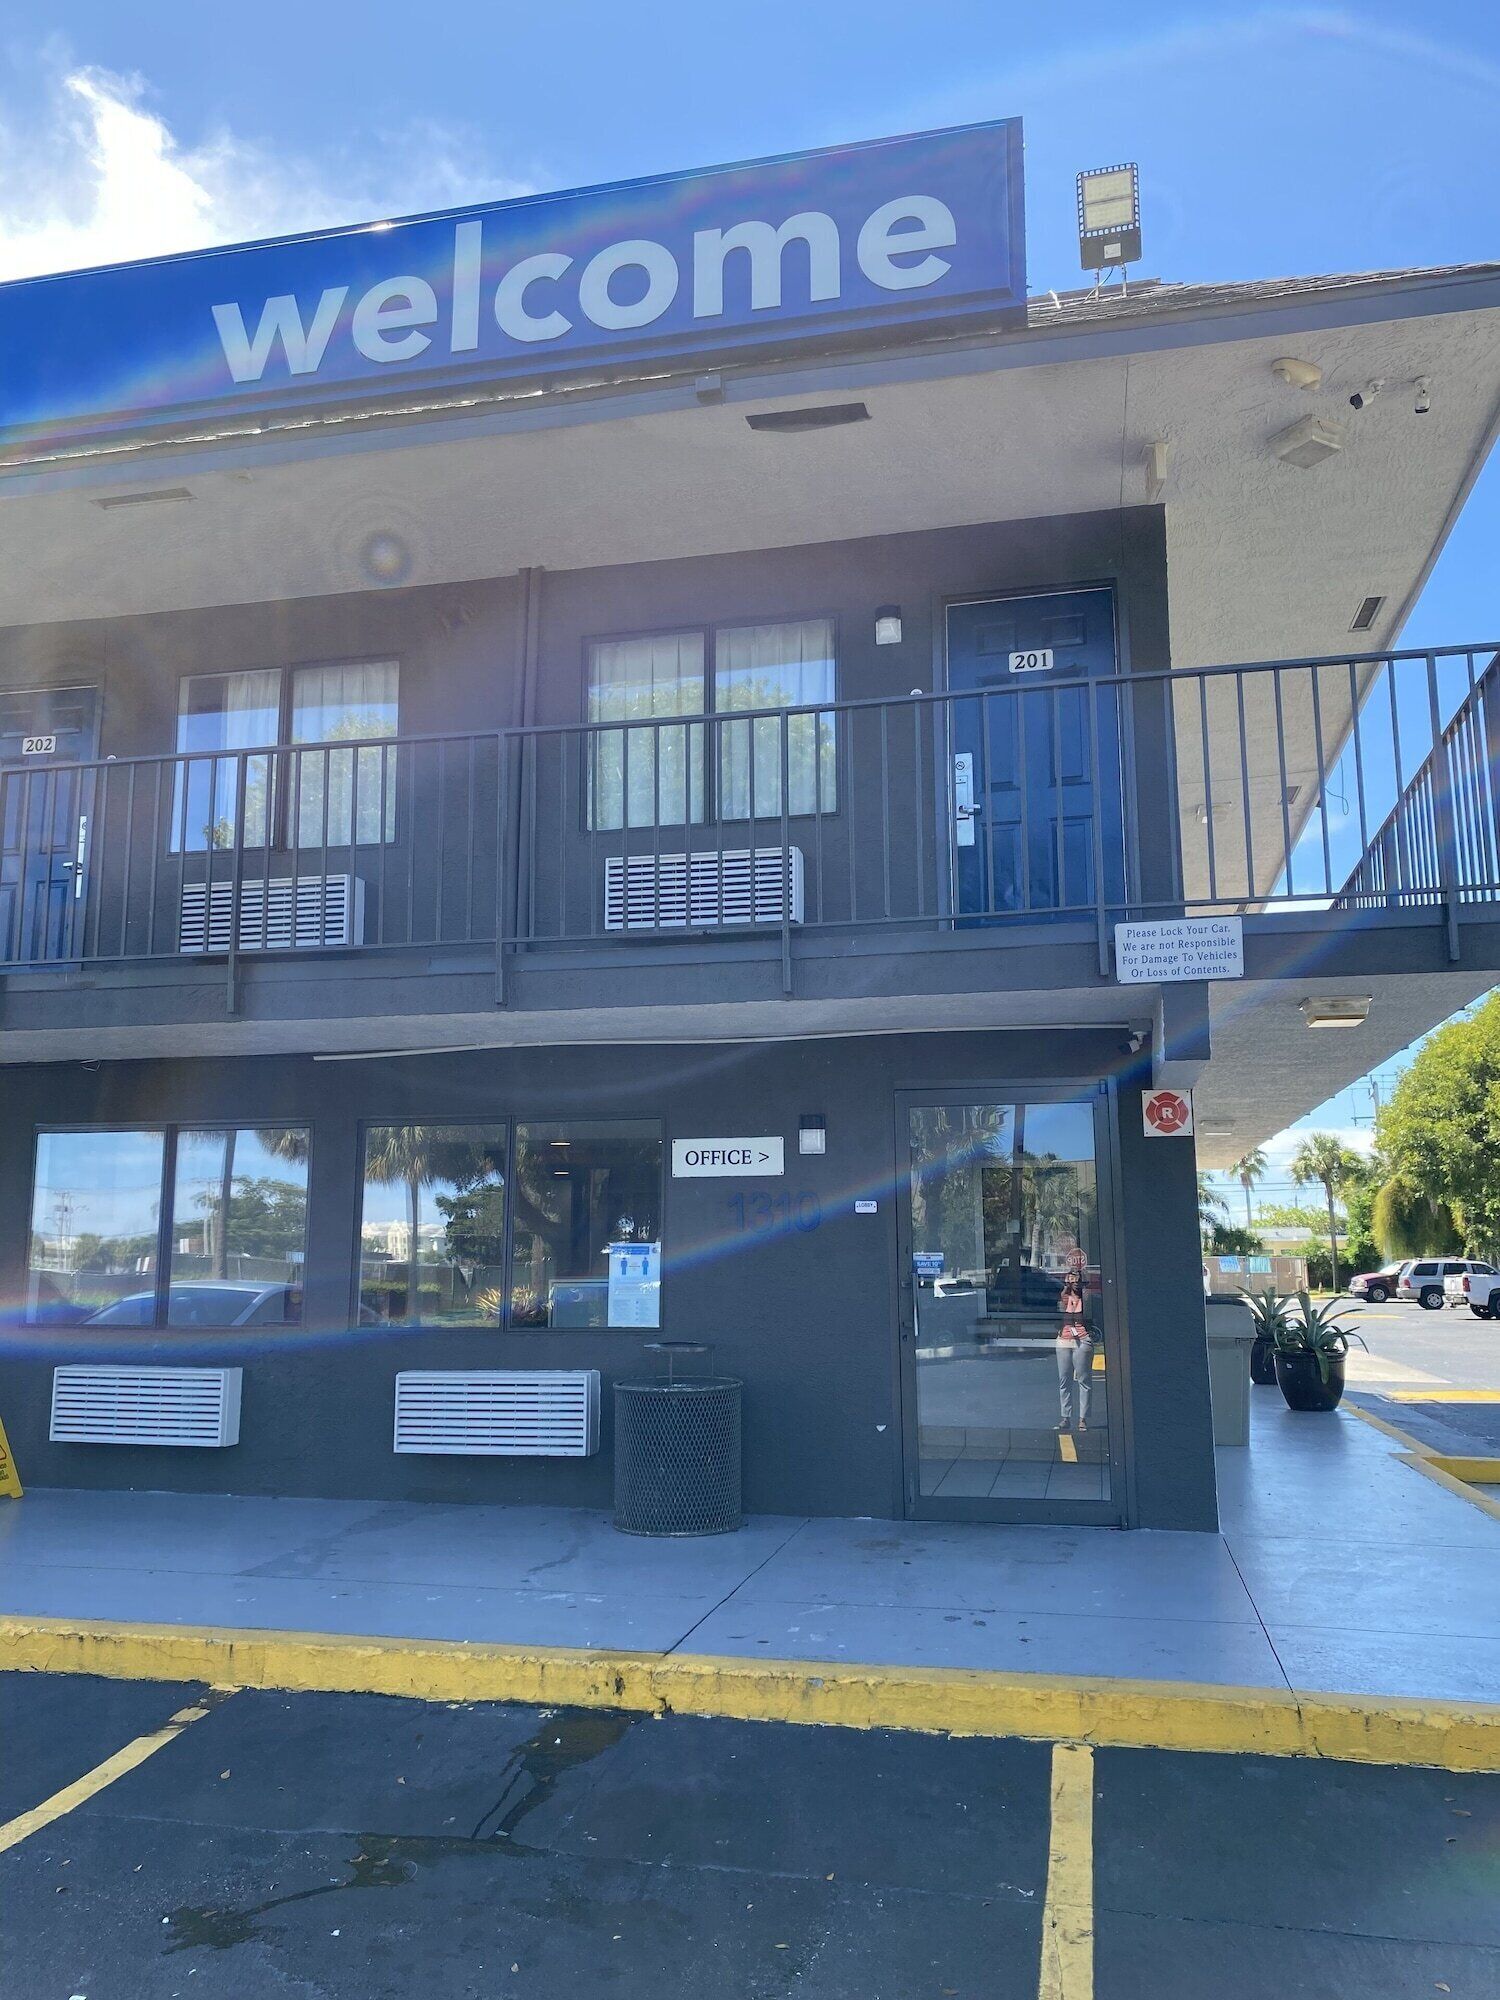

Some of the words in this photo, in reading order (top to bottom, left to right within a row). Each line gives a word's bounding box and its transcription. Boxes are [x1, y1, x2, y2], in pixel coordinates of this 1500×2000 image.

[211, 193, 957, 384] welcome
[1014, 652, 1048, 670] 201
[25, 738, 53, 753] 202
[1126, 929, 1157, 938] Please
[1160, 926, 1183, 936] Lock
[1186, 925, 1208, 935] Your
[1211, 923, 1231, 934] Car.
[1122, 942, 1137, 951] We
[1140, 943, 1155, 951] are
[1159, 941, 1175, 950] not
[1178, 936, 1236, 950] Responsible
[1122, 956, 1138, 965] For
[1141, 953, 1179, 966] Damage
[1182, 953, 1194, 962] To
[1197, 950, 1238, 961] Vehicles
[1131, 968, 1144, 977] Or
[1147, 967, 1168, 977] Loss
[1171, 965, 1181, 975] of
[1183, 965, 1230, 975] Contents.
[1161, 1107, 1174, 1119] R
[685, 1149, 752, 1166] OFFICE
[728, 1191, 823, 1233] 1310
